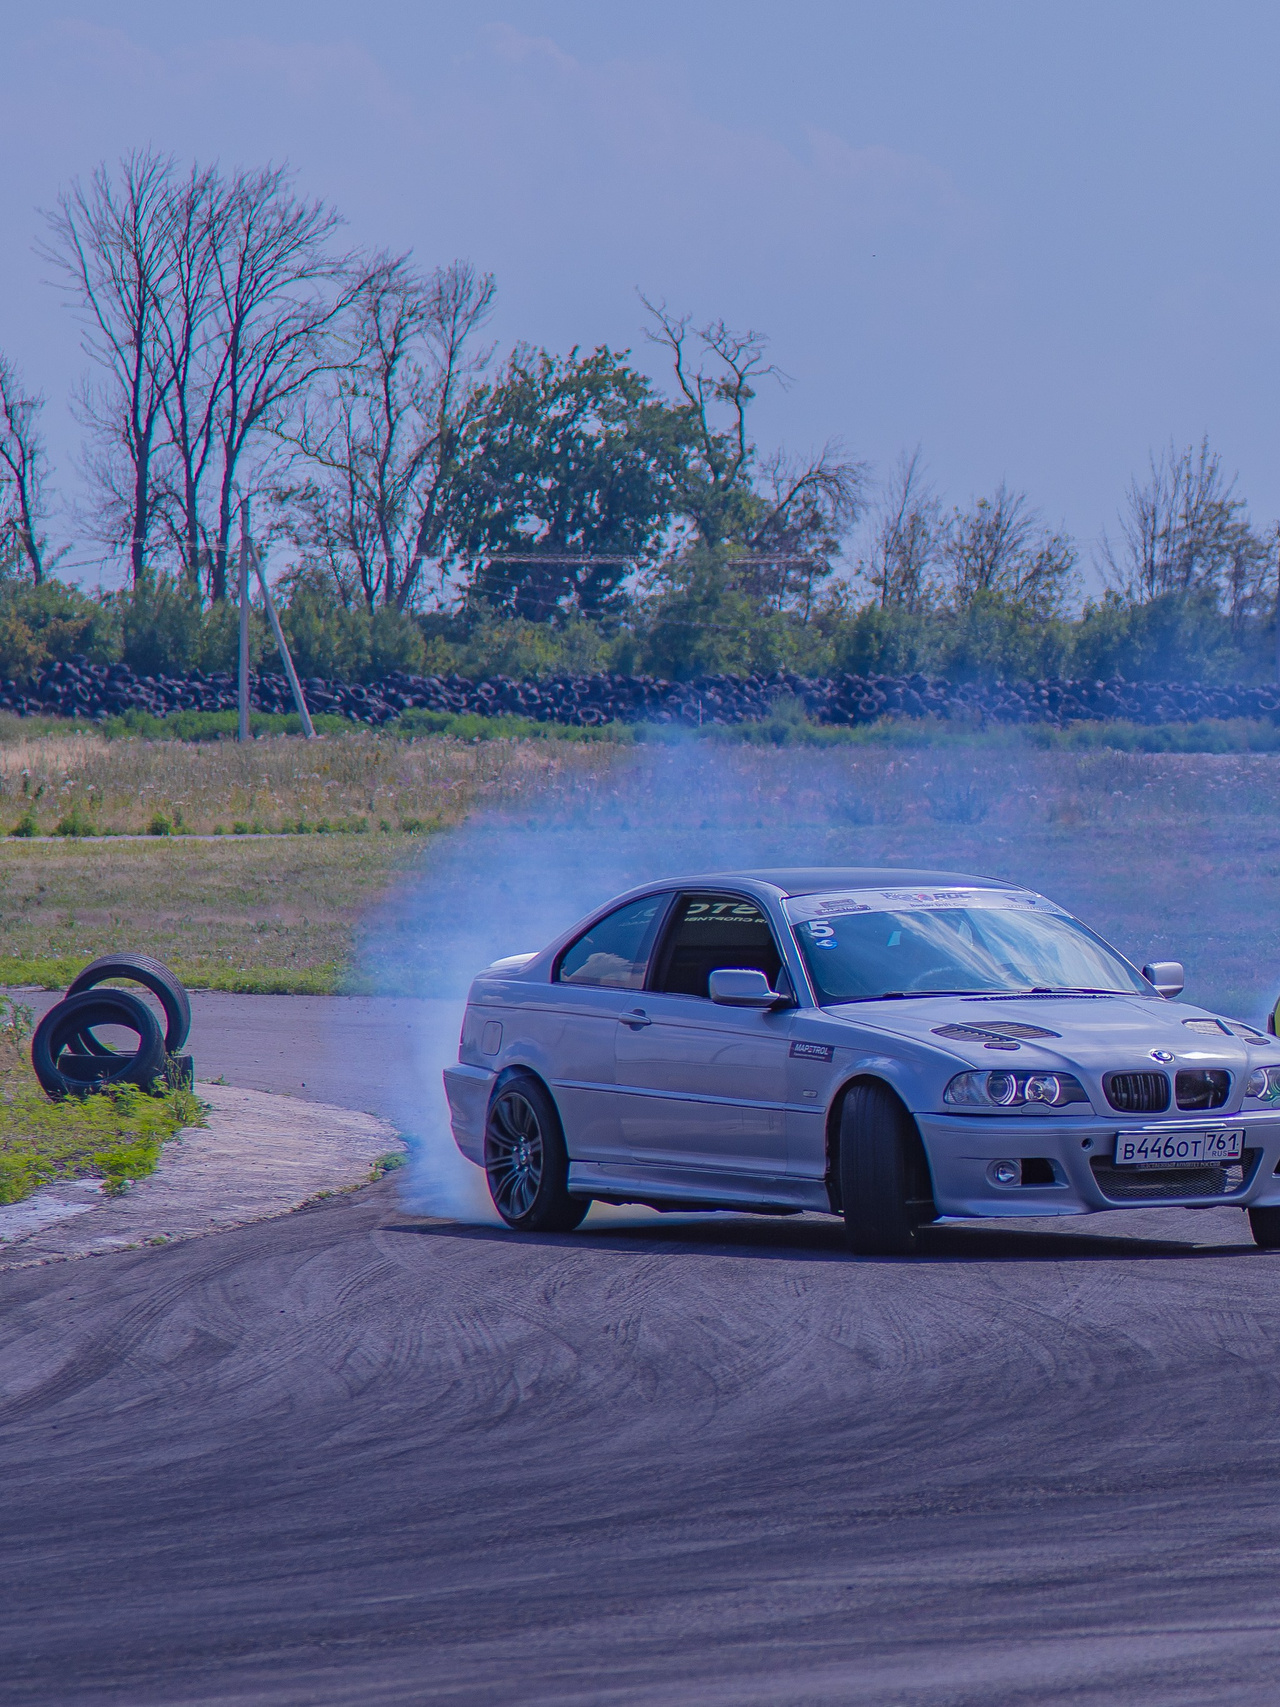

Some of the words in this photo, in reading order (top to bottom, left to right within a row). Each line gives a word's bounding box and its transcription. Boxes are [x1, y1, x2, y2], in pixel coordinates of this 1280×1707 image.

[808, 920, 835, 938] 5
[794, 1043, 829, 1055] MAPETROL
[1206, 1133, 1237, 1151] 761
